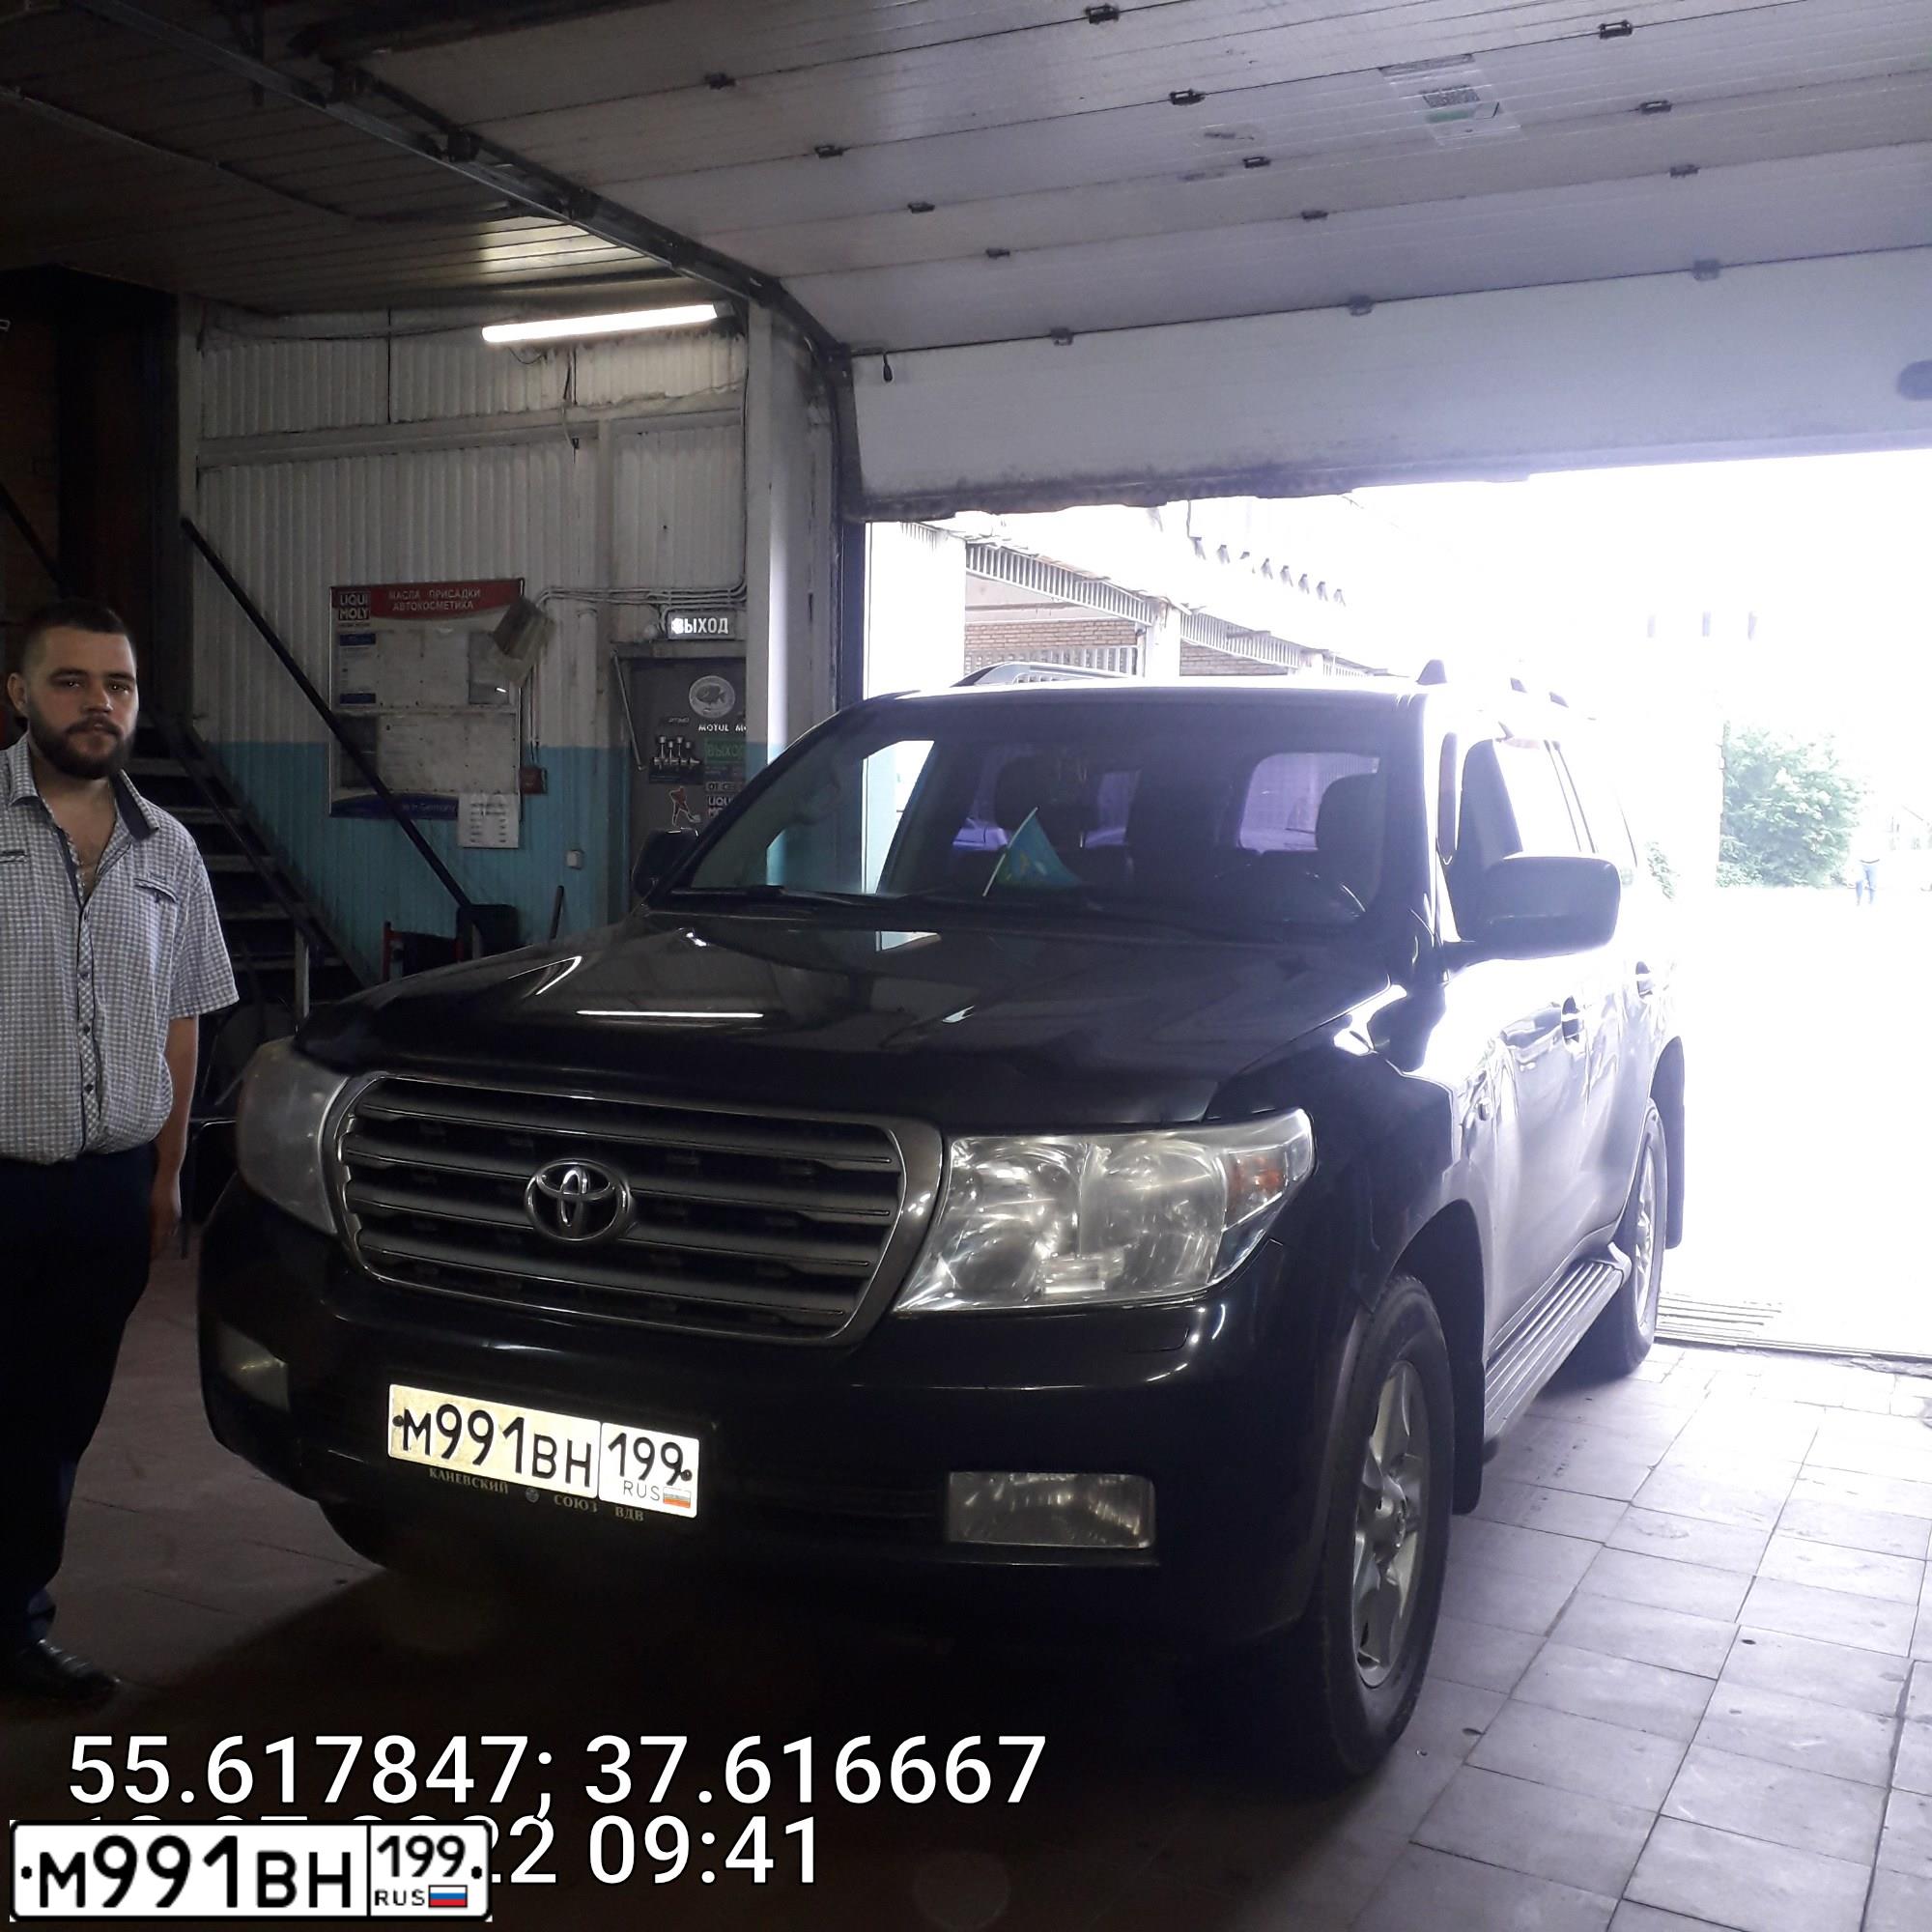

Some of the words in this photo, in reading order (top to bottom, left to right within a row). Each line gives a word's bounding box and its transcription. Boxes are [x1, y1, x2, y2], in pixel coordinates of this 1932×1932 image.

[340, 593, 368, 606] LIQUI
[388, 589, 421, 600] МАСЛА
[429, 587, 481, 600] ПРИСАДКИ
[392, 600, 474, 611] АВТОКОСМЕТИКА
[339, 607, 369, 619] MOLY
[697, 724, 729, 732] MOTUL
[402, 1404, 592, 1489] М991ВН
[608, 1432, 684, 1487] 199
[428, 1466, 509, 1495] КАНЕВСКИЙ
[554, 1494, 598, 1513] СОЮЗ
[614, 1506, 644, 1522] ВДВ
[623, 1481, 661, 1501] RUS
